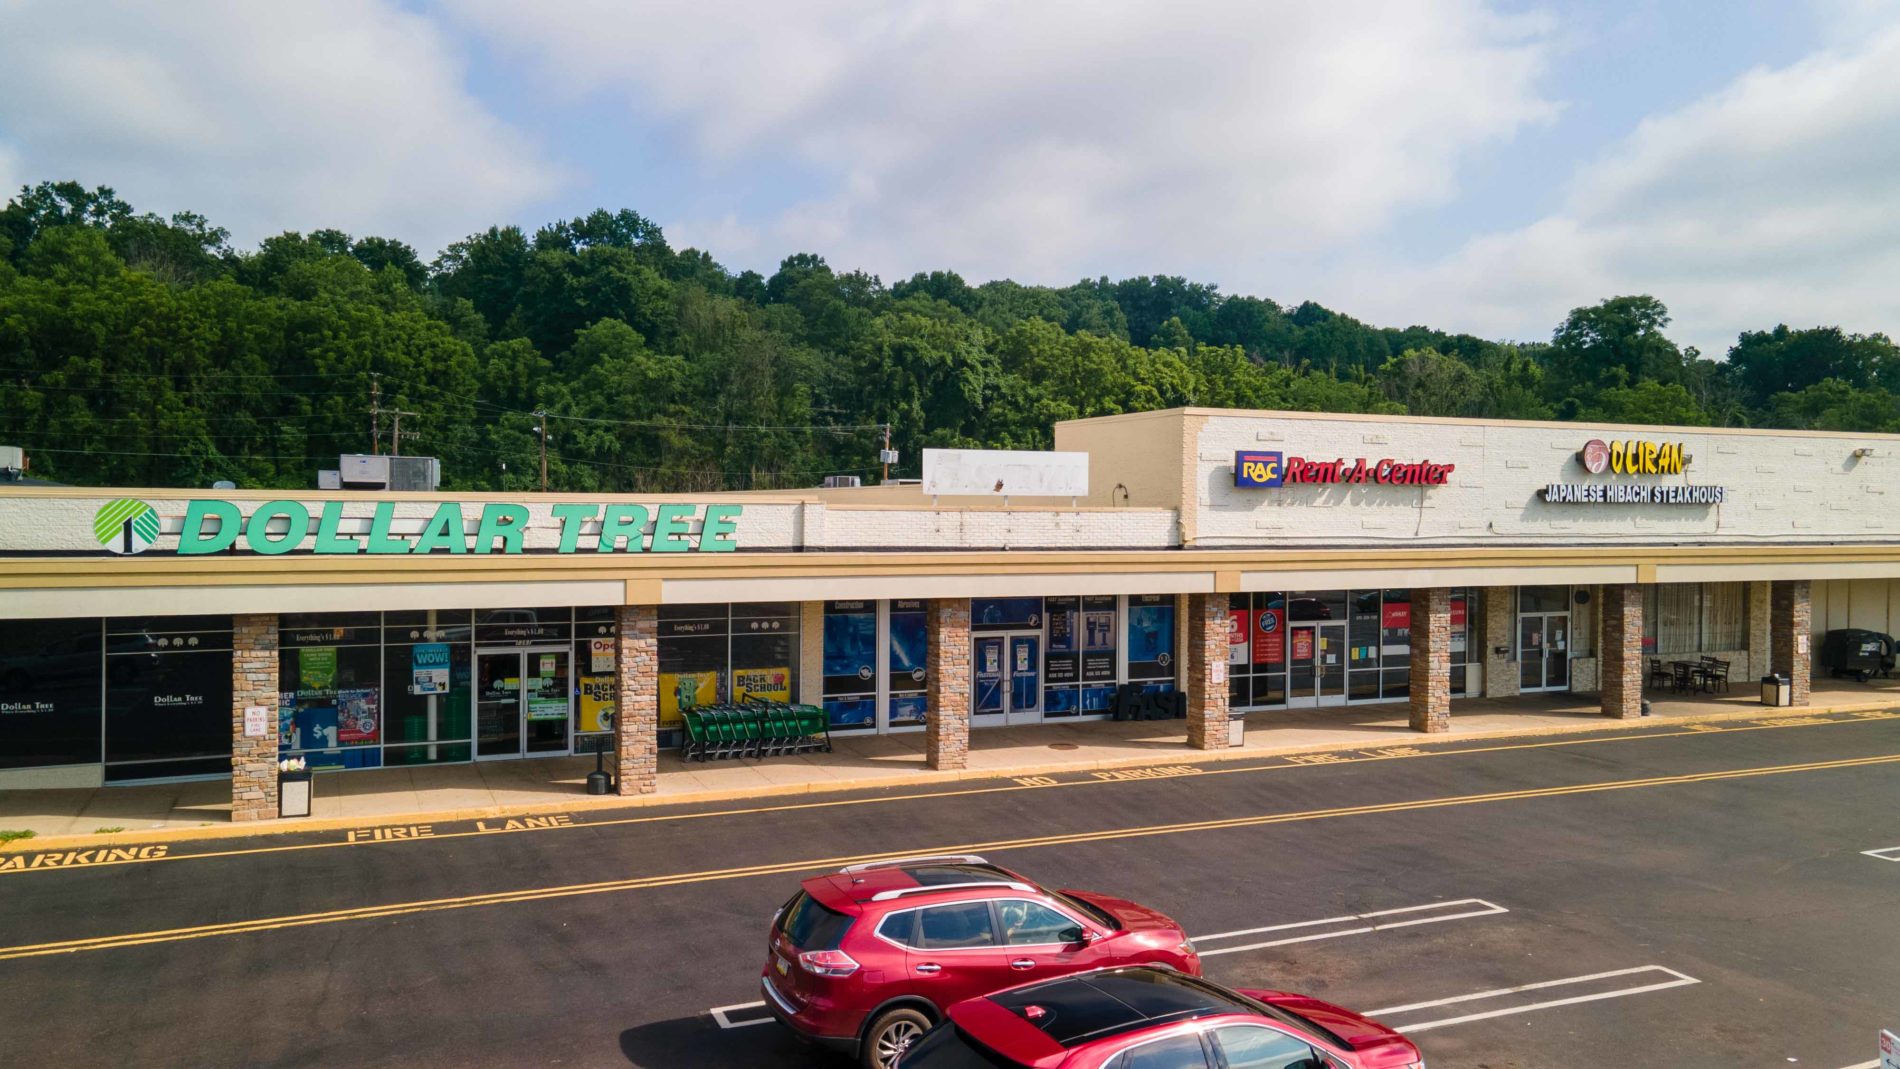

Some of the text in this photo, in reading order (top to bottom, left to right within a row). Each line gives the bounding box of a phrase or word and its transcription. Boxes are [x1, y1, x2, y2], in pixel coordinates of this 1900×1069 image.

[1242, 461, 1278, 483] RAC
[1545, 484, 1603, 503] JAPANESE
[1606, 485, 1651, 503] HIBACHI
[177, 499, 744, 554] DOLLAR TREE
[416, 652, 449, 664] WOW!
[736, 674, 766, 687] BACK
[745, 682, 787, 693] SCHOOL
[1012, 765, 1203, 788] NO PARKING
[347, 815, 575, 843] FIRE LANE
